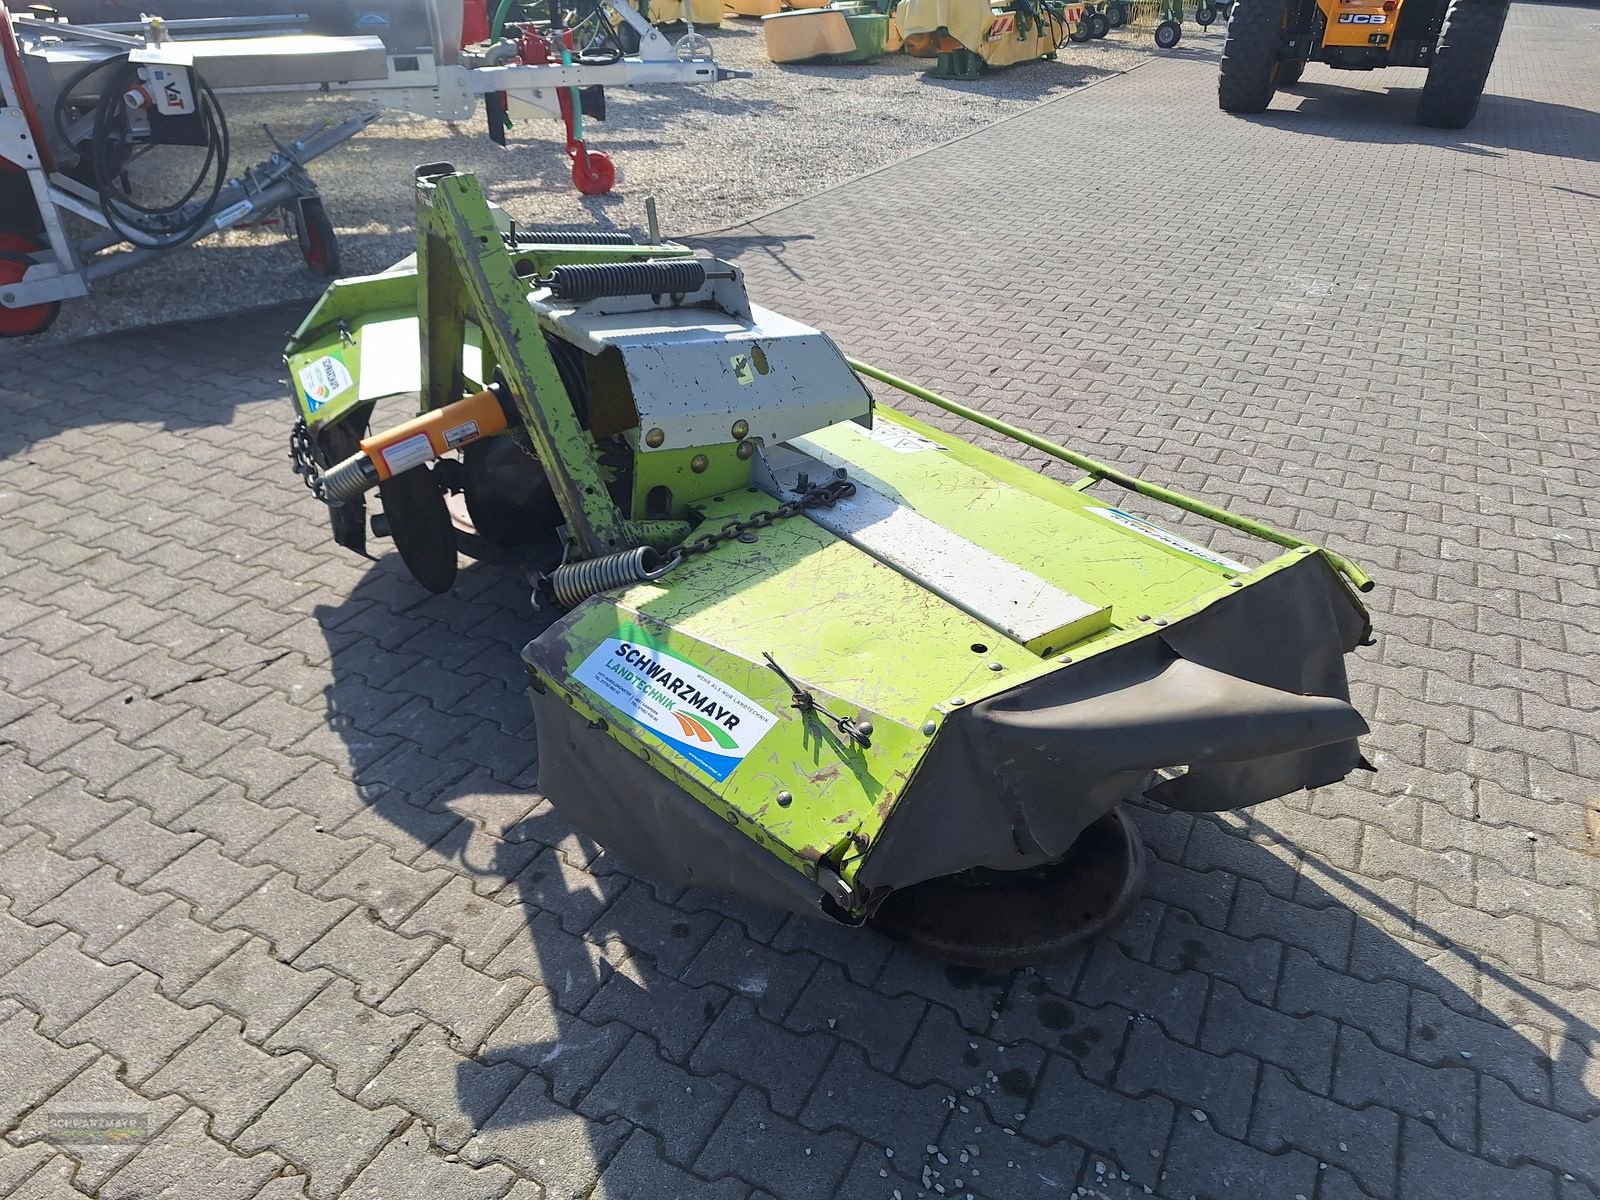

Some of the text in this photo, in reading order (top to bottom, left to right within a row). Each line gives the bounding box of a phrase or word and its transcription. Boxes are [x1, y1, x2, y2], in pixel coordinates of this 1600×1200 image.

[1339, 14, 1387, 24] JCB
[605, 658, 677, 711] LANDTECHNIK
[615, 643, 740, 731] SCHWARZMAYR
[696, 674, 711, 685] MEHR
[711, 683, 722, 692] ALS
[722, 690, 734, 699] NUR
